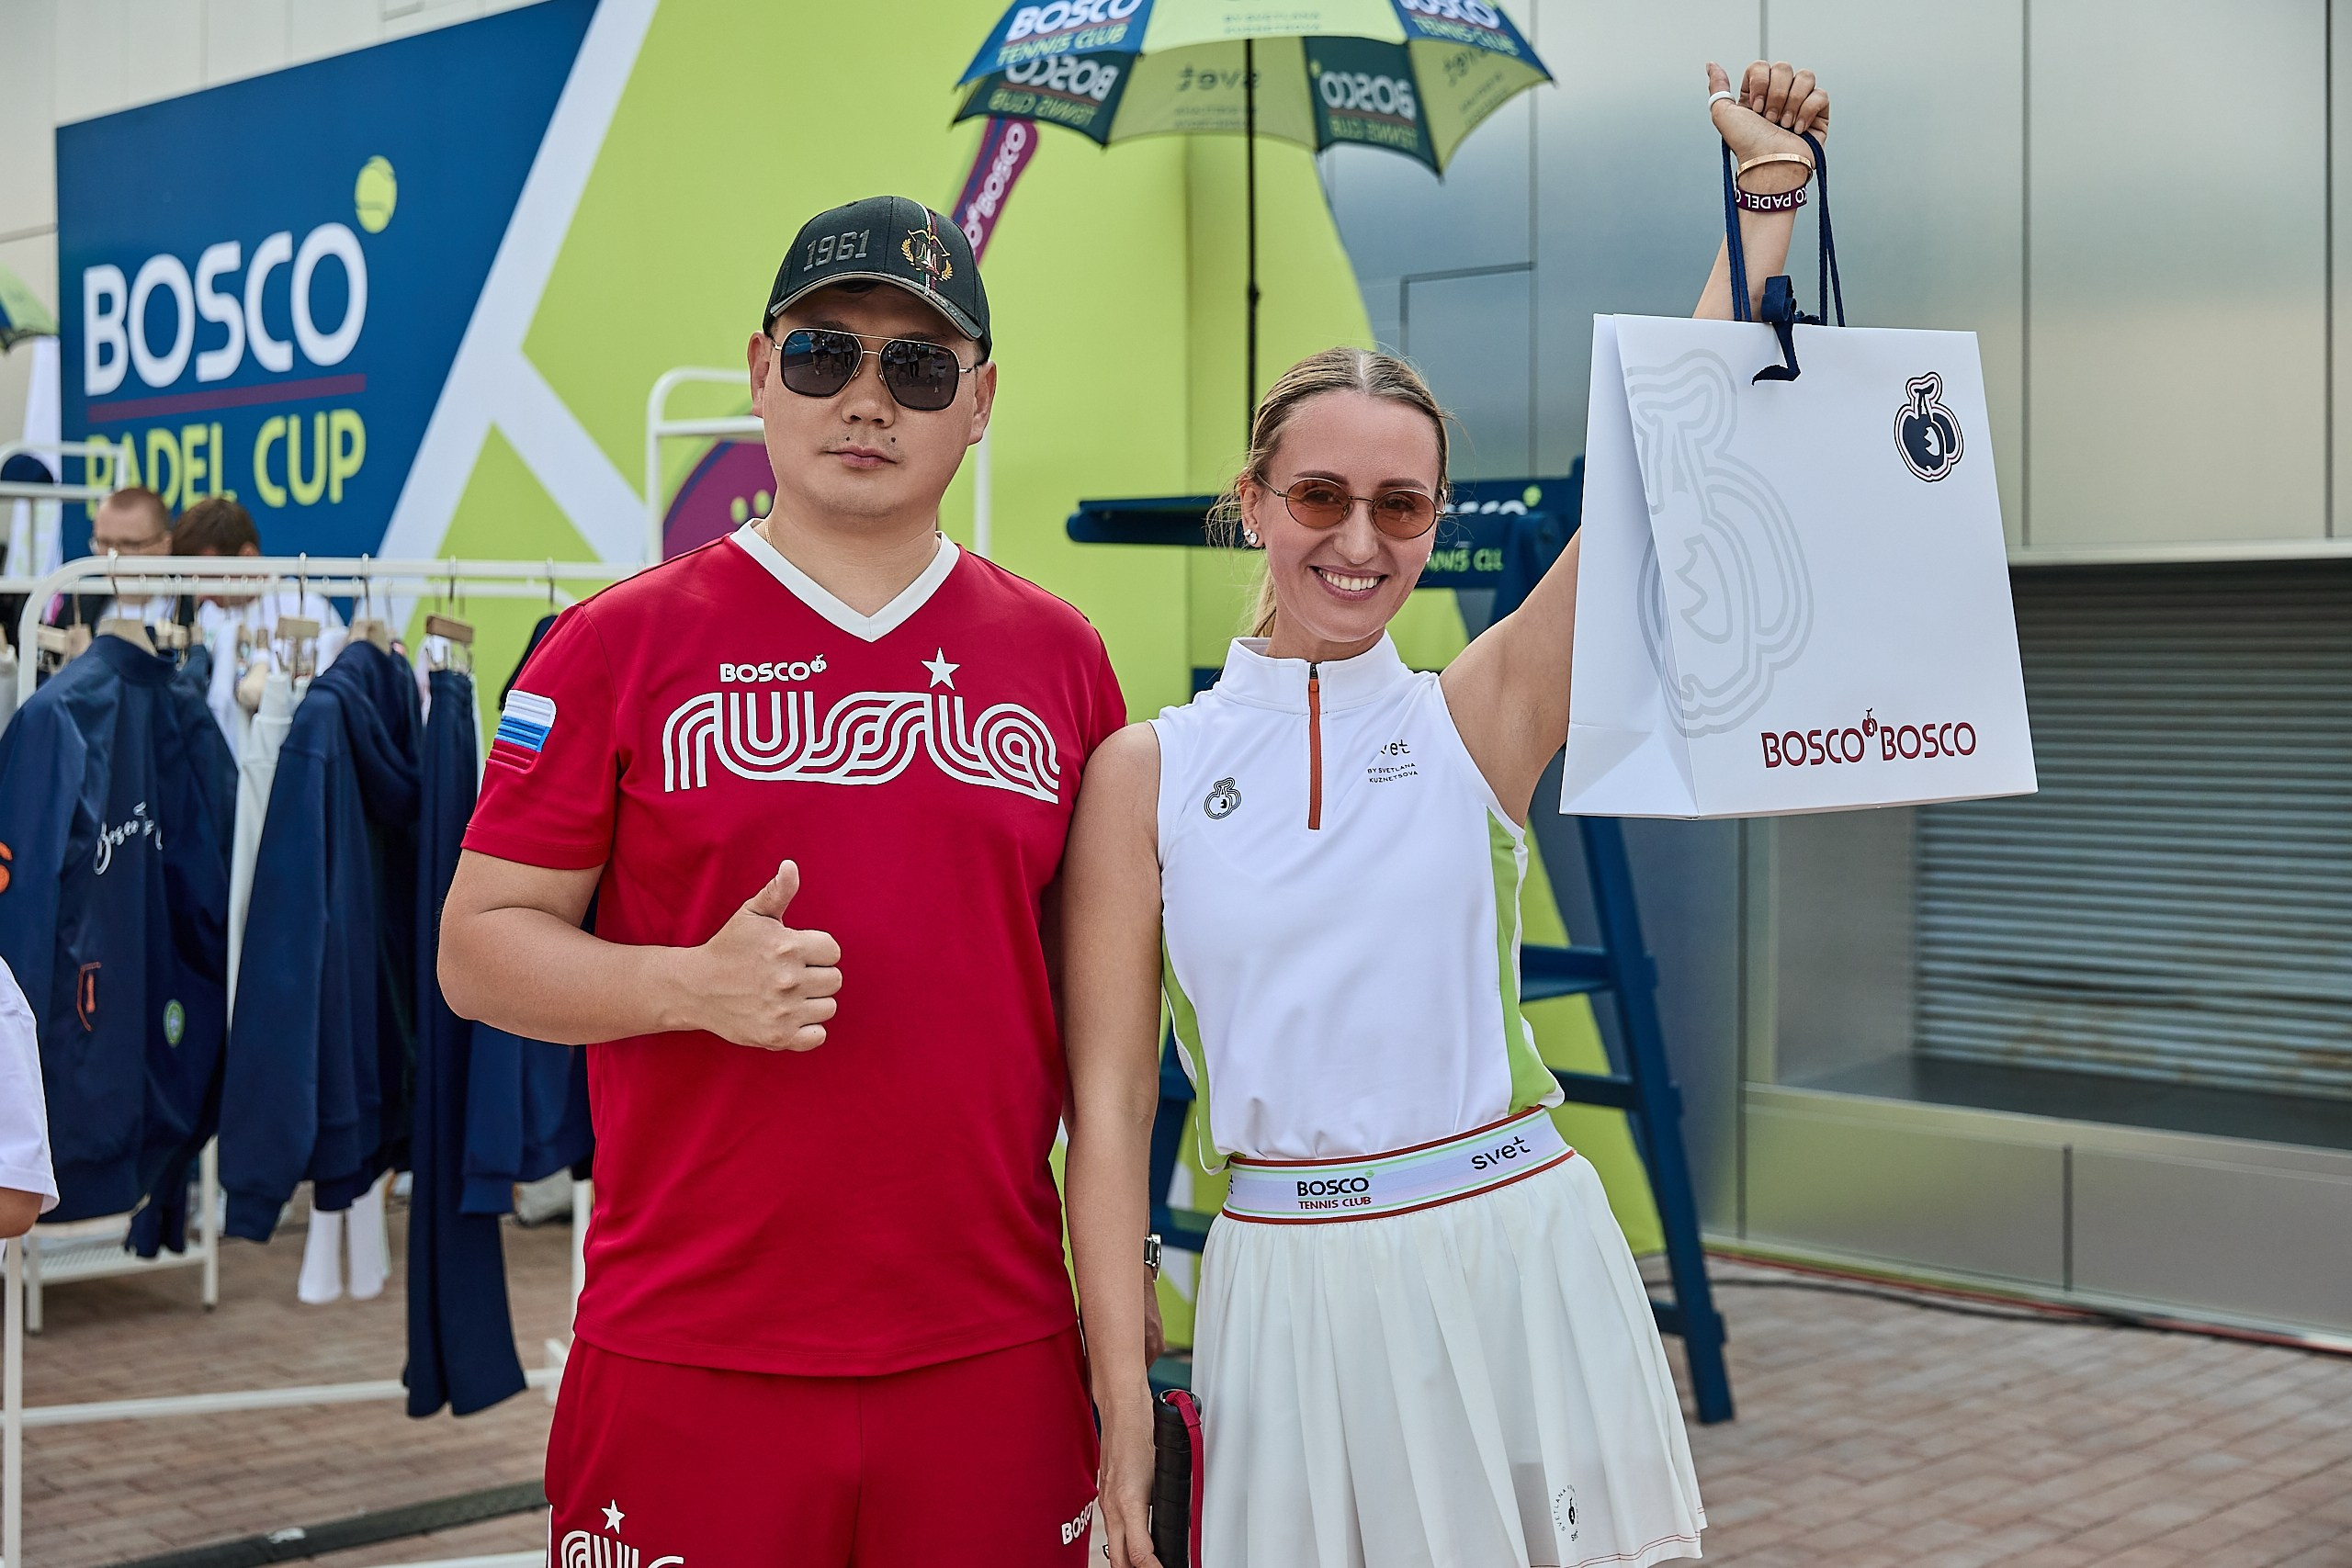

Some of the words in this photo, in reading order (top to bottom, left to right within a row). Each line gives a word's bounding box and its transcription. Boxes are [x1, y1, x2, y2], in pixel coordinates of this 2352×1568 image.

[1005, 0, 1140, 42] BOSCO
[996, 33, 1074, 66] TENNIS
[1075, 23, 1128, 48] CLUB
[1746, 193, 1792, 209] PADEL
[803, 229, 870, 272] 1961
[83, 222, 368, 396] BOSCO
[253, 408, 367, 508] CUP
[720, 662, 811, 682] BOSCO
[1761, 728, 1865, 768] BOSCO
[1881, 722, 1976, 761] BOSCO
[1369, 771, 1419, 783] KUZNETSOVA
[1378, 762, 1416, 773] SVETLANA
[1471, 1136, 1532, 1170] svet
[1296, 1177, 1370, 1197] BOSCO
[1298, 1200, 1339, 1210] TENNIS
[1342, 1196, 1372, 1208] CLUB
